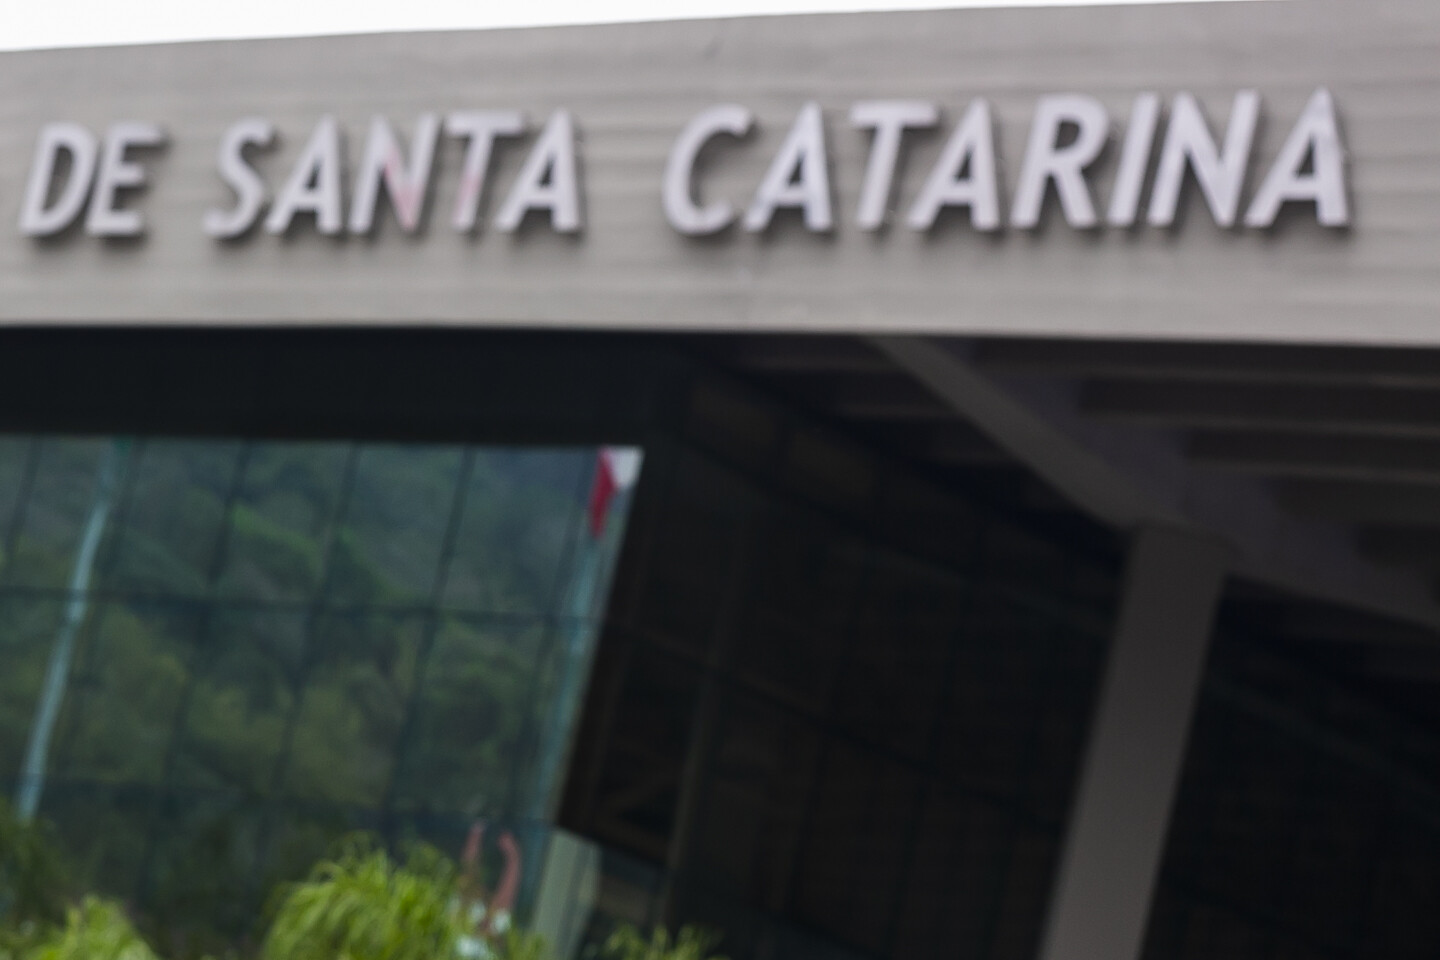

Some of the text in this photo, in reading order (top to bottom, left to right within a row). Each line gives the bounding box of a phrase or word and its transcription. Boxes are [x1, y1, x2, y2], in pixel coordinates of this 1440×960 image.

[19, 121, 162, 239] DE
[204, 108, 583, 239] SANTA
[661, 87, 1350, 236] CATARINA
